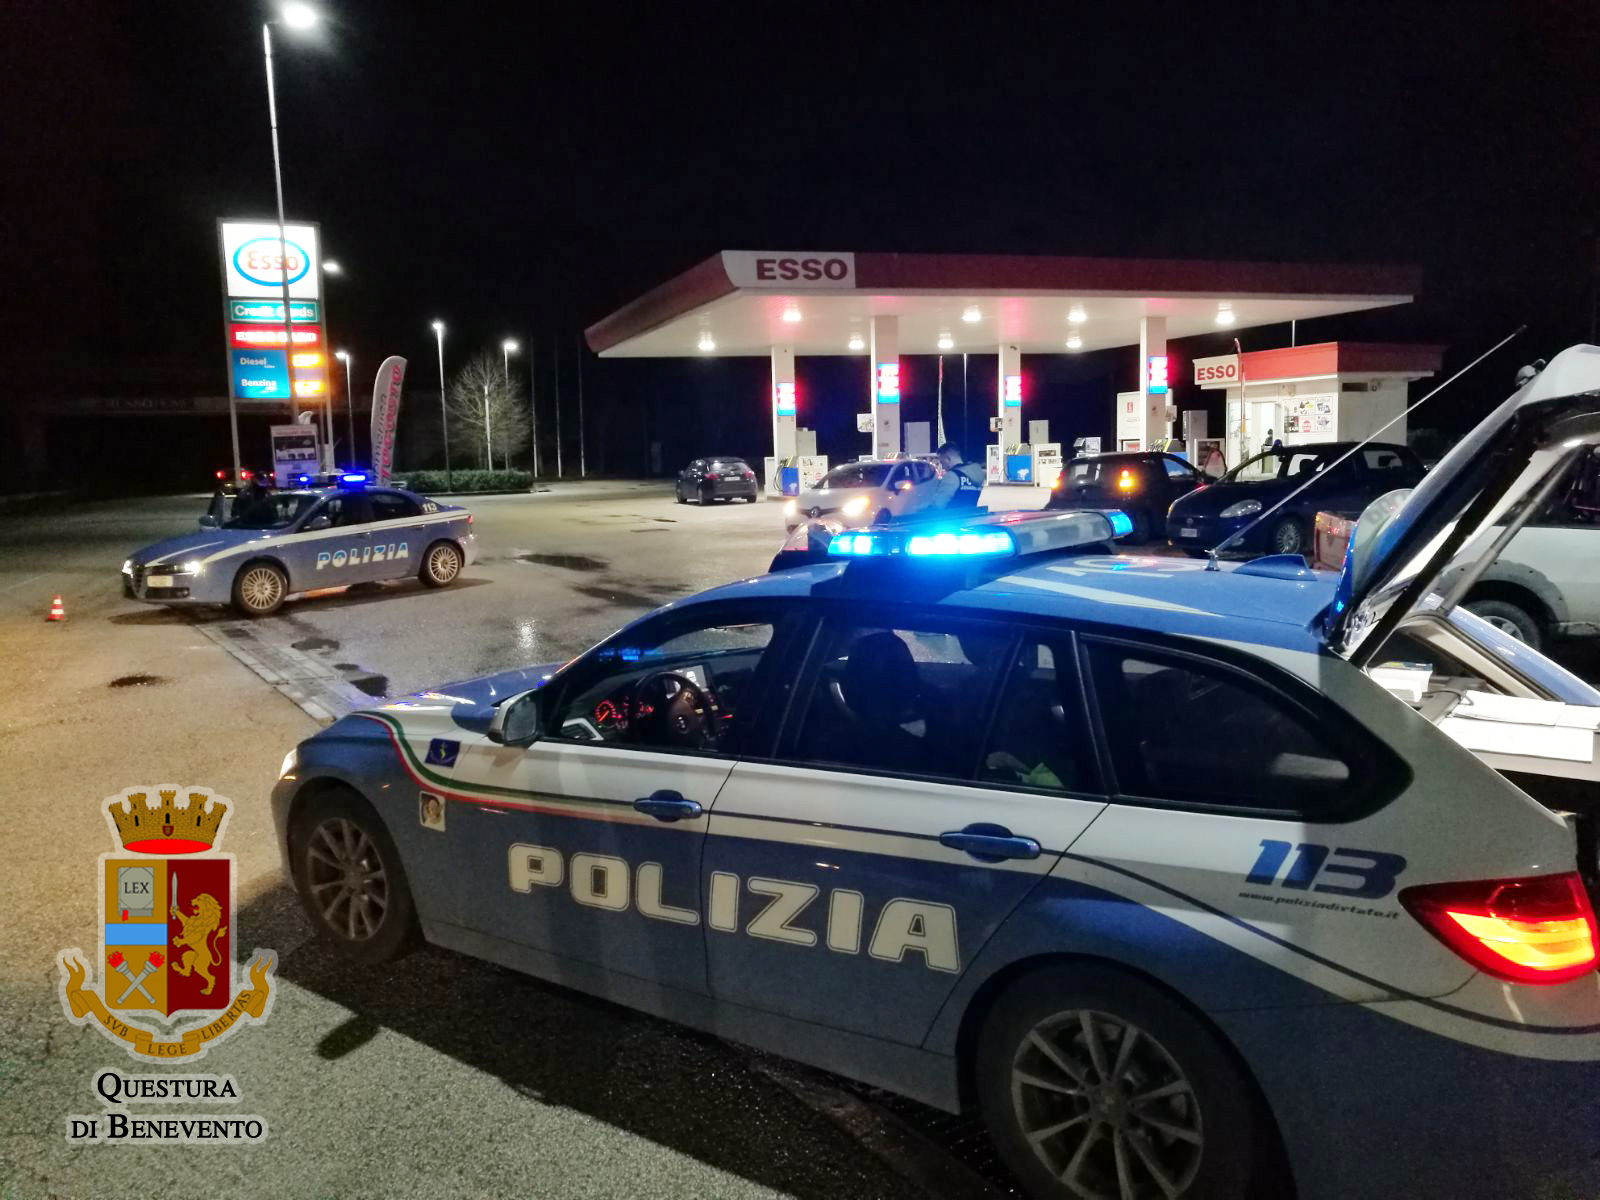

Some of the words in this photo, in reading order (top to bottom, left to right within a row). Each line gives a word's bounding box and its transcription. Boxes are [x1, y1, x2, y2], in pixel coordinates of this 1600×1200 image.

[756, 258, 847, 280] ESSO
[239, 357, 267, 365] Diesel
[1197, 363, 1237, 381] ESSO
[422, 503, 438, 513] 113
[315, 542, 409, 570] POLIZIA
[1245, 839, 1407, 900] 113
[507, 842, 961, 975] POLIZIA
